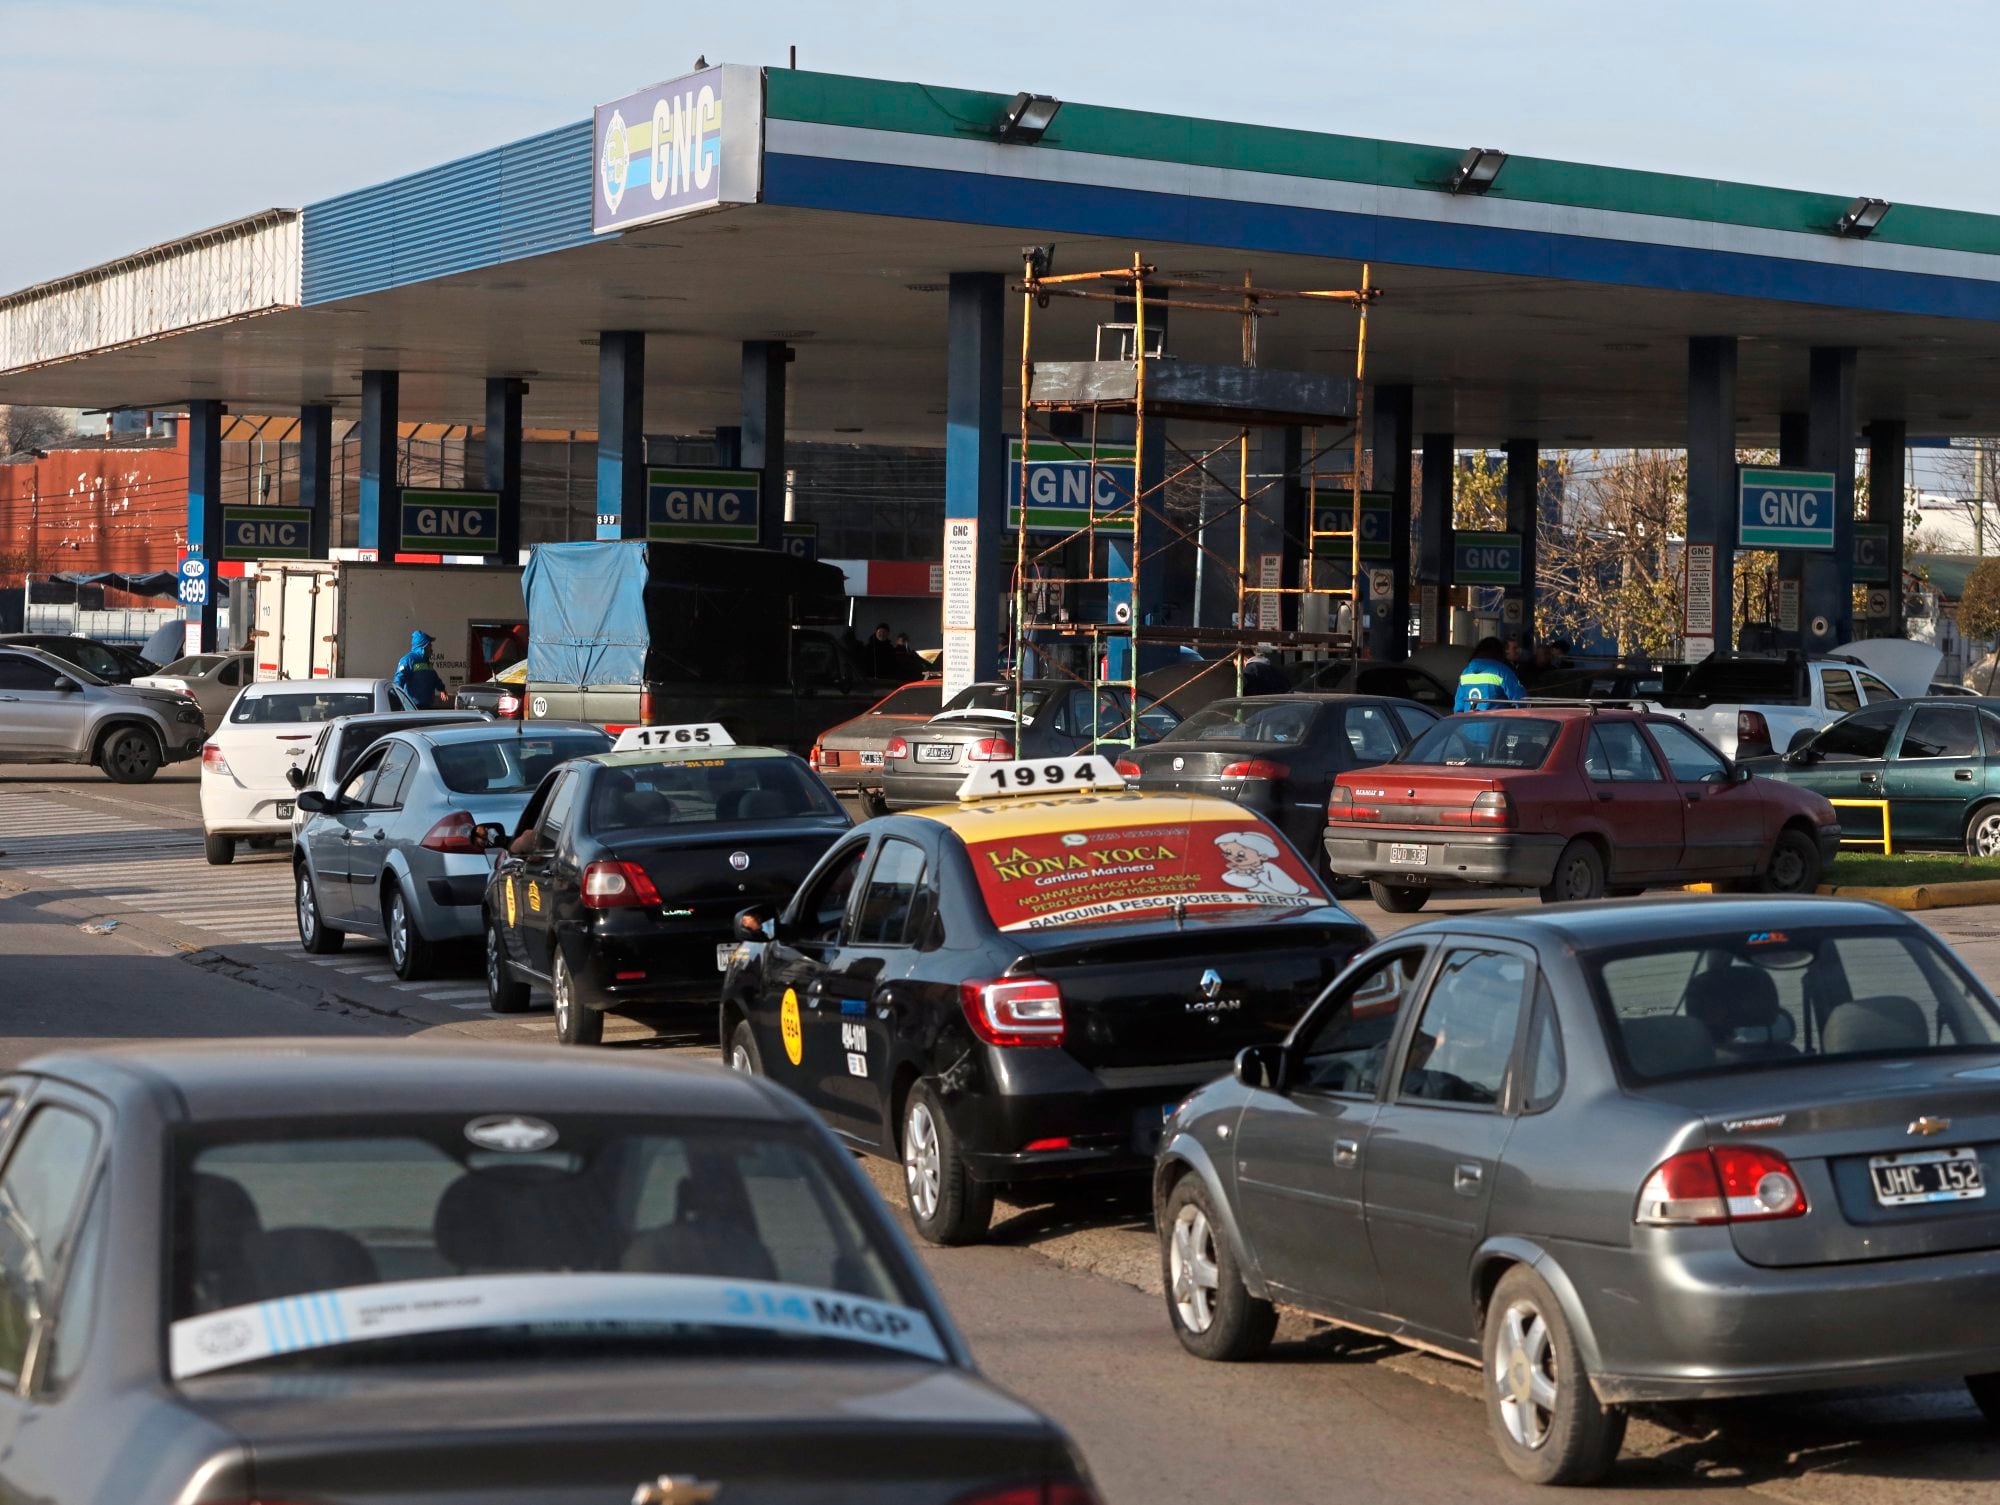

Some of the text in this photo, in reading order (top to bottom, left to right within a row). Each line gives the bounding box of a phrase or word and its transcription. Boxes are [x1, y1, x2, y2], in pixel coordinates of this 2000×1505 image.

[651, 85, 715, 200] GNC
[1030, 467, 1116, 506] GNC
[665, 490, 740, 522] GNC
[1759, 490, 1818, 526] GNC
[417, 508, 482, 535] GNC
[597, 515, 615, 525] 699
[952, 525, 969, 537] GNC
[237, 522, 296, 545] GNC
[1465, 548, 1511, 569] GNC
[1691, 547, 1710, 556] GNC
[185, 563, 202, 574] GNC
[179, 578, 206, 603] $699
[436, 661, 468, 669] VERDURAS
[534, 698, 546, 713] 110
[637, 728, 711, 745] 1765
[990, 763, 1096, 788] 1994
[987, 846, 1032, 867] LA
[996, 845, 1177, 882] NONA YOCA
[1391, 848, 1426, 861] BVD 338
[1034, 863, 1155, 887] Cantina Marinera
[1018, 895, 1040, 907] NO
[1041, 879, 1129, 901] INVENTAMOS
[1130, 875, 1157, 886] LAS
[1031, 899, 1066, 913] PERO
[1068, 894, 1097, 906] SON
[1099, 889, 1126, 900] LAS
[1029, 902, 1118, 928] BANQUINA
[1119, 894, 1234, 912] PESCADORES
[1245, 894, 1311, 906] PUERTO
[1184, 999, 1241, 1012] LOGAN
[1882, 1160, 1981, 1197] JHC 152
